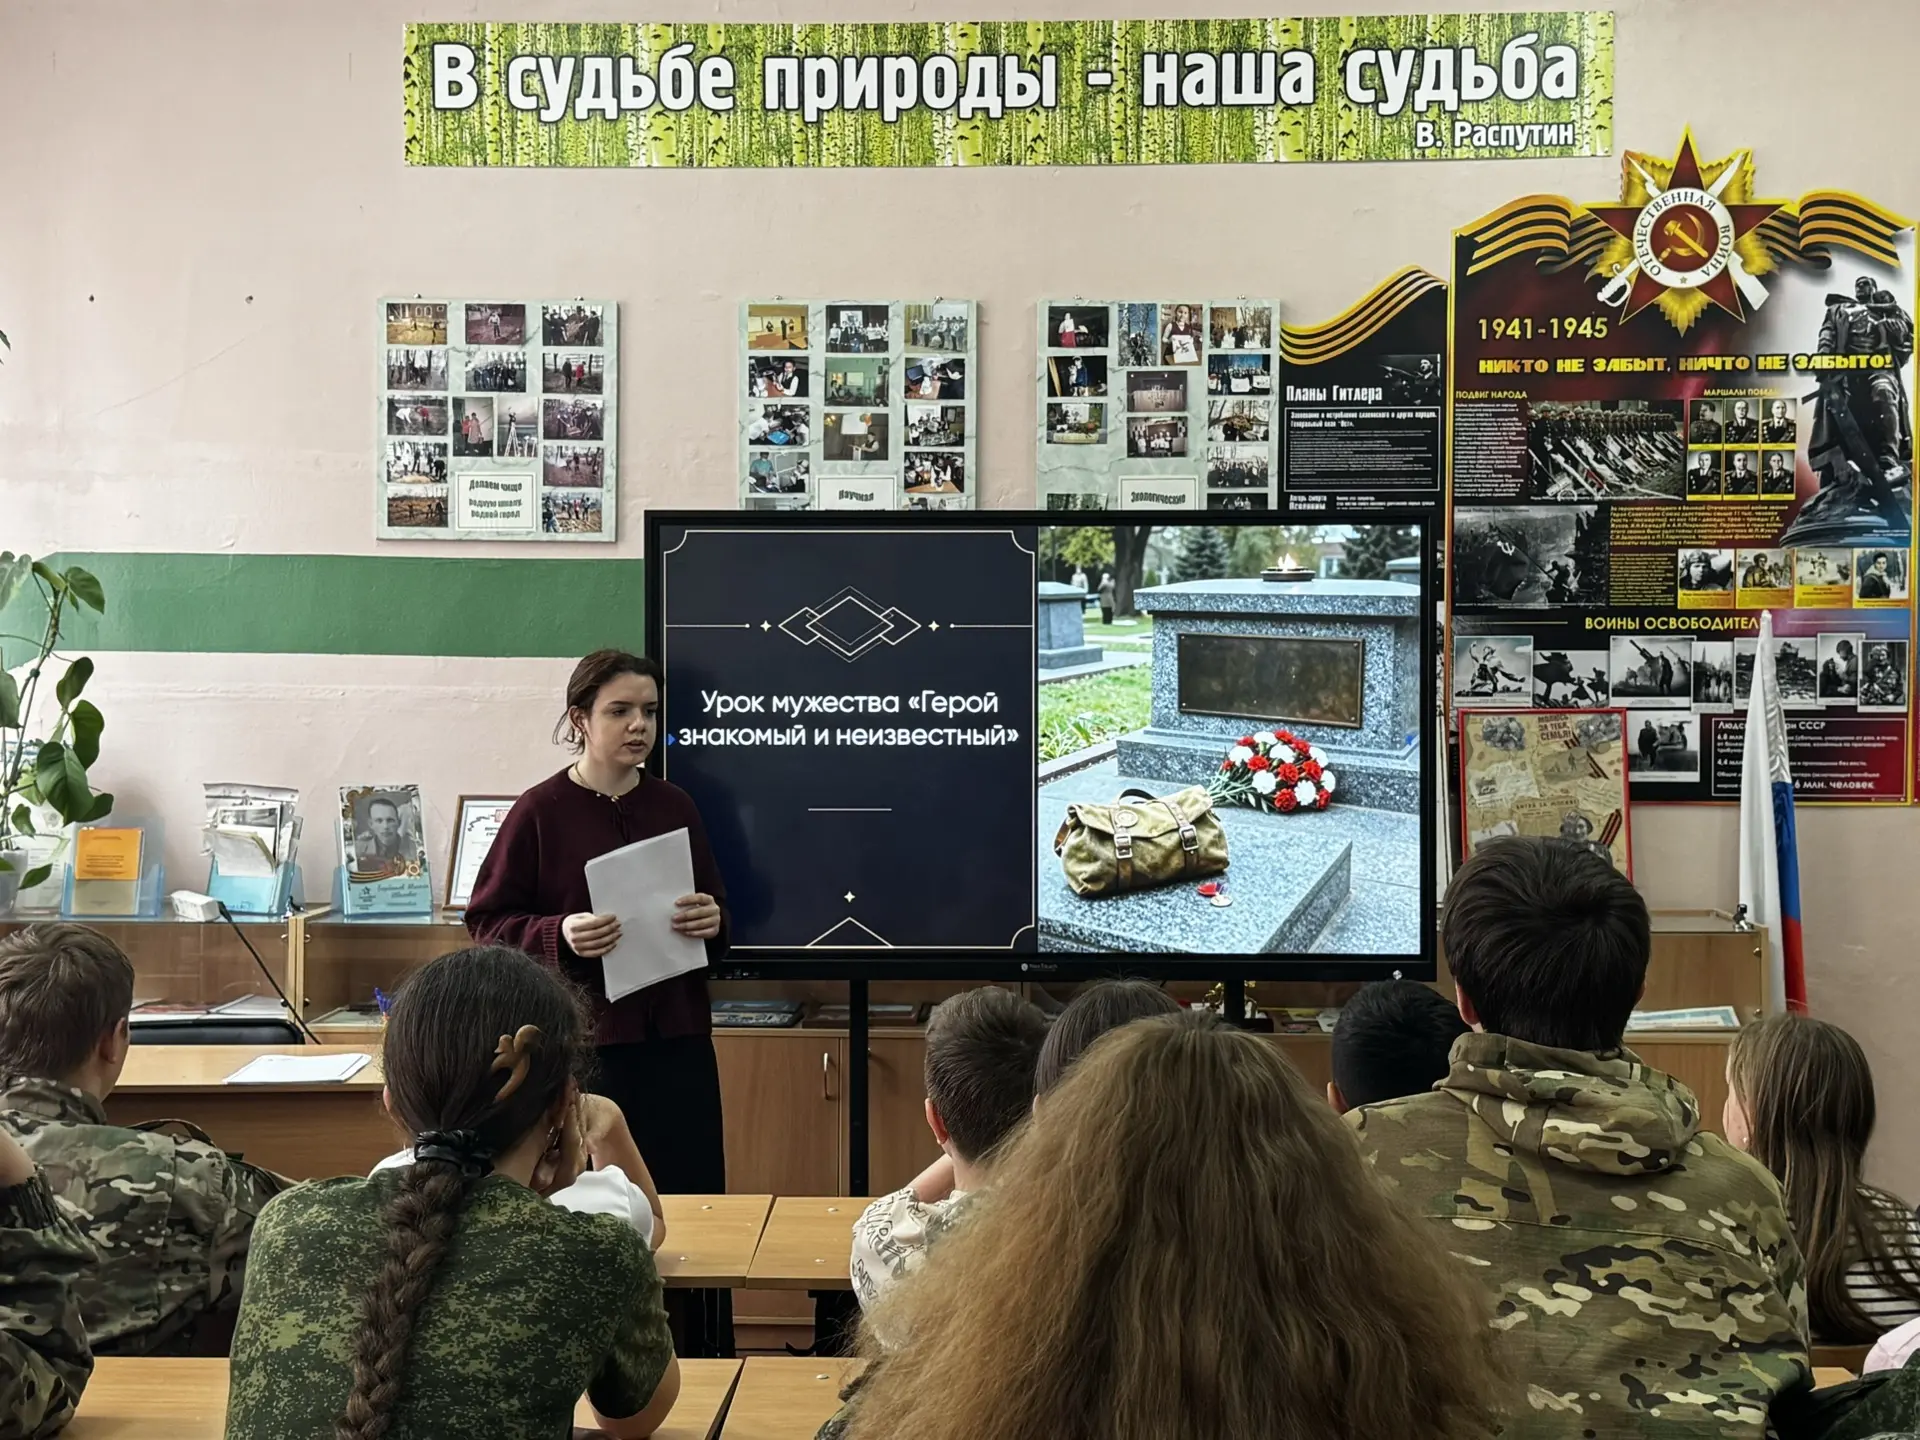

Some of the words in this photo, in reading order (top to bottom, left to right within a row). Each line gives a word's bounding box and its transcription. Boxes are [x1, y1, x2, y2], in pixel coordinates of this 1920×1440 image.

[430, 42, 481, 111] В
[506, 42, 737, 125] судьбе
[762, 53, 1058, 125] природы
[1086, 69, 1114, 87] -
[1142, 47, 1317, 108] наша
[1344, 31, 1578, 116] судьба
[1414, 121, 1442, 149] В.
[1453, 119, 1576, 152] Распутин
[1635, 190, 1717, 277] ОТЕЧЕСТВЕННАЯ
[1700, 224, 1731, 278] ВОЙНА
[1478, 317, 1608, 340] 1941-1945
[1478, 358, 1549, 375] НИКТО
[1555, 358, 1585, 374] НЕ
[1592, 356, 1671, 373] ЗАБЫТ,
[1679, 355, 1751, 372] НИЧТО
[1757, 354, 1787, 371] НЕ
[1795, 353, 1893, 371] ЗАБЫТО!
[1286, 385, 1327, 401] Планы
[1332, 386, 1383, 404] Гитлера
[1455, 390, 1489, 399] ПОДВИГ
[1491, 390, 1528, 399] НАРОДА
[1703, 388, 1746, 396] МАРШАЛЫ
[468, 479, 500, 492] Делаем
[1584, 616, 1640, 630] ВОИНЫ
[1644, 616, 1760, 631] ОСВОБОДИТЕЛ
[700, 689, 766, 718] Урок
[771, 693, 900, 719] мужества
[907, 689, 999, 718] «Герой
[678, 724, 807, 747] знакомый
[814, 728, 830, 746] и
[836, 723, 1020, 747] неизвестный»
[1718, 721, 1747, 730] Людс
[1798, 722, 1826, 730] СССР
